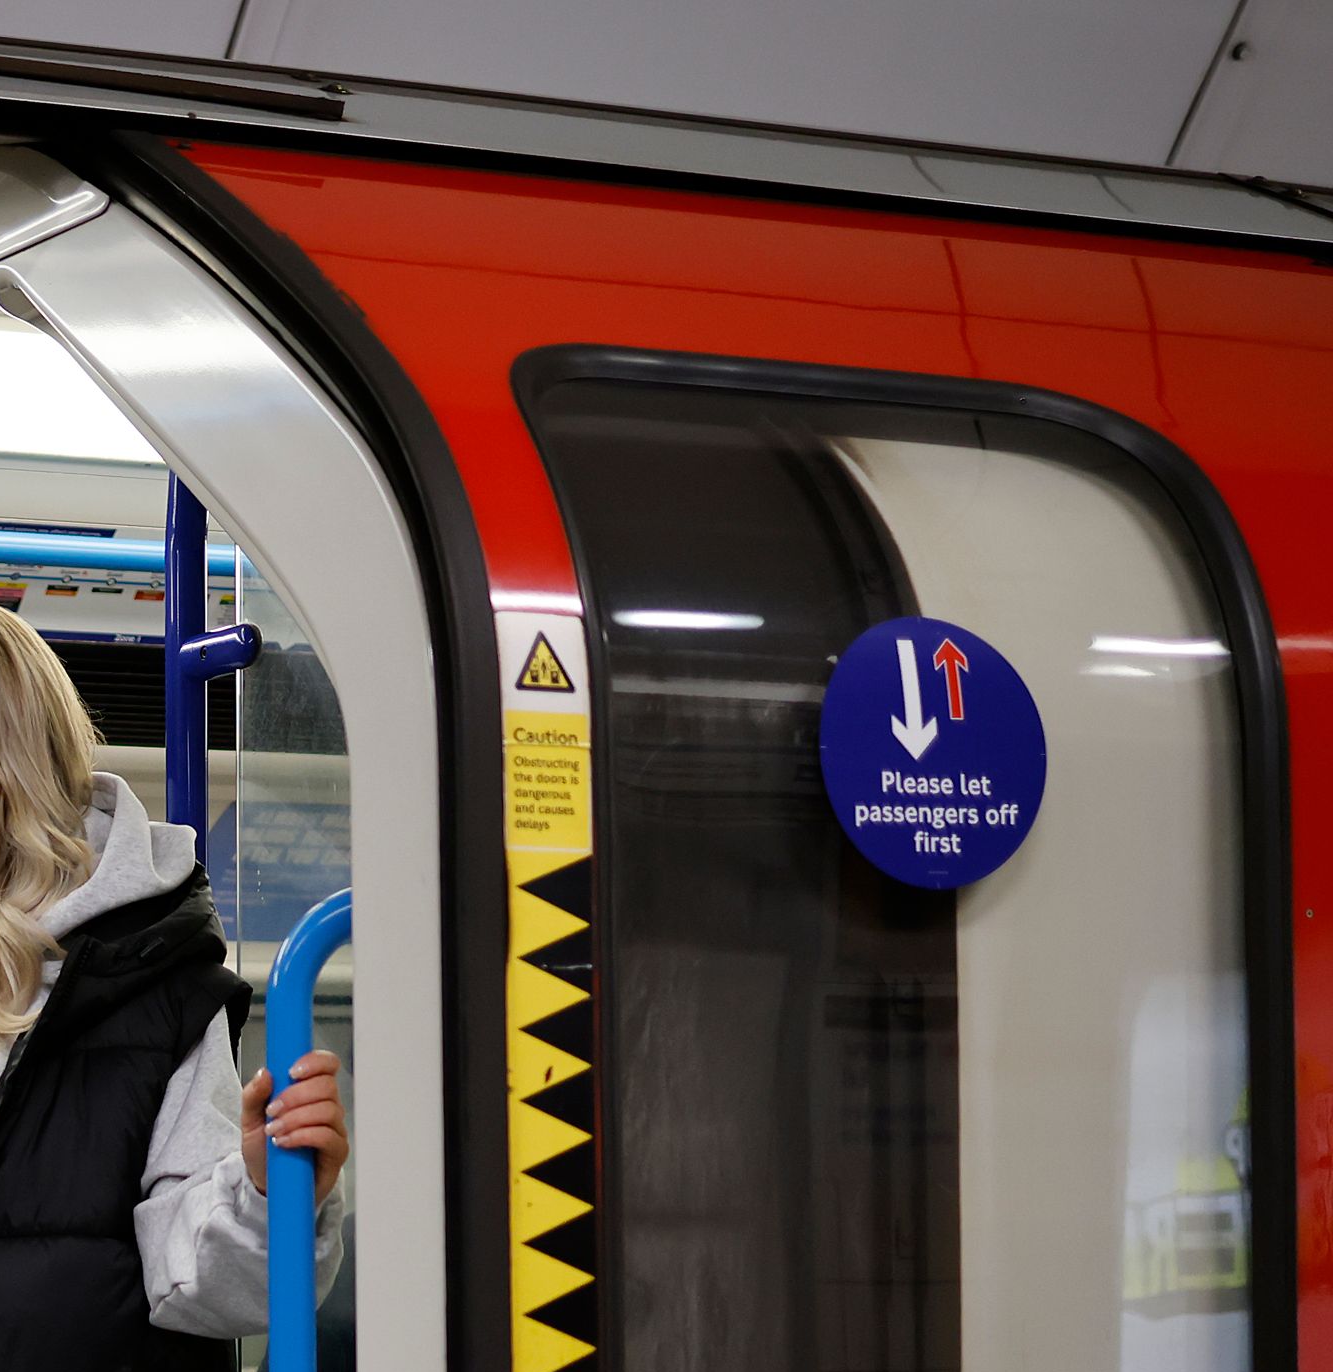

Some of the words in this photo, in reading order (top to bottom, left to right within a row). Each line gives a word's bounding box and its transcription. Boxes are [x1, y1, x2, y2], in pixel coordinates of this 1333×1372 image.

[513, 727, 578, 745] Caution
[514, 755, 580, 771] Obstructing
[514, 773, 533, 783] the
[536, 773, 567, 785] doors
[570, 774, 579, 785] is
[882, 771, 953, 794] Please
[960, 773, 991, 795] let
[514, 788, 571, 801] dangerous
[515, 803, 535, 813] and
[539, 804, 575, 815] causes
[855, 805, 979, 829] passengers
[985, 804, 1019, 825] off
[515, 818, 550, 830] delays
[914, 831, 961, 853] first
